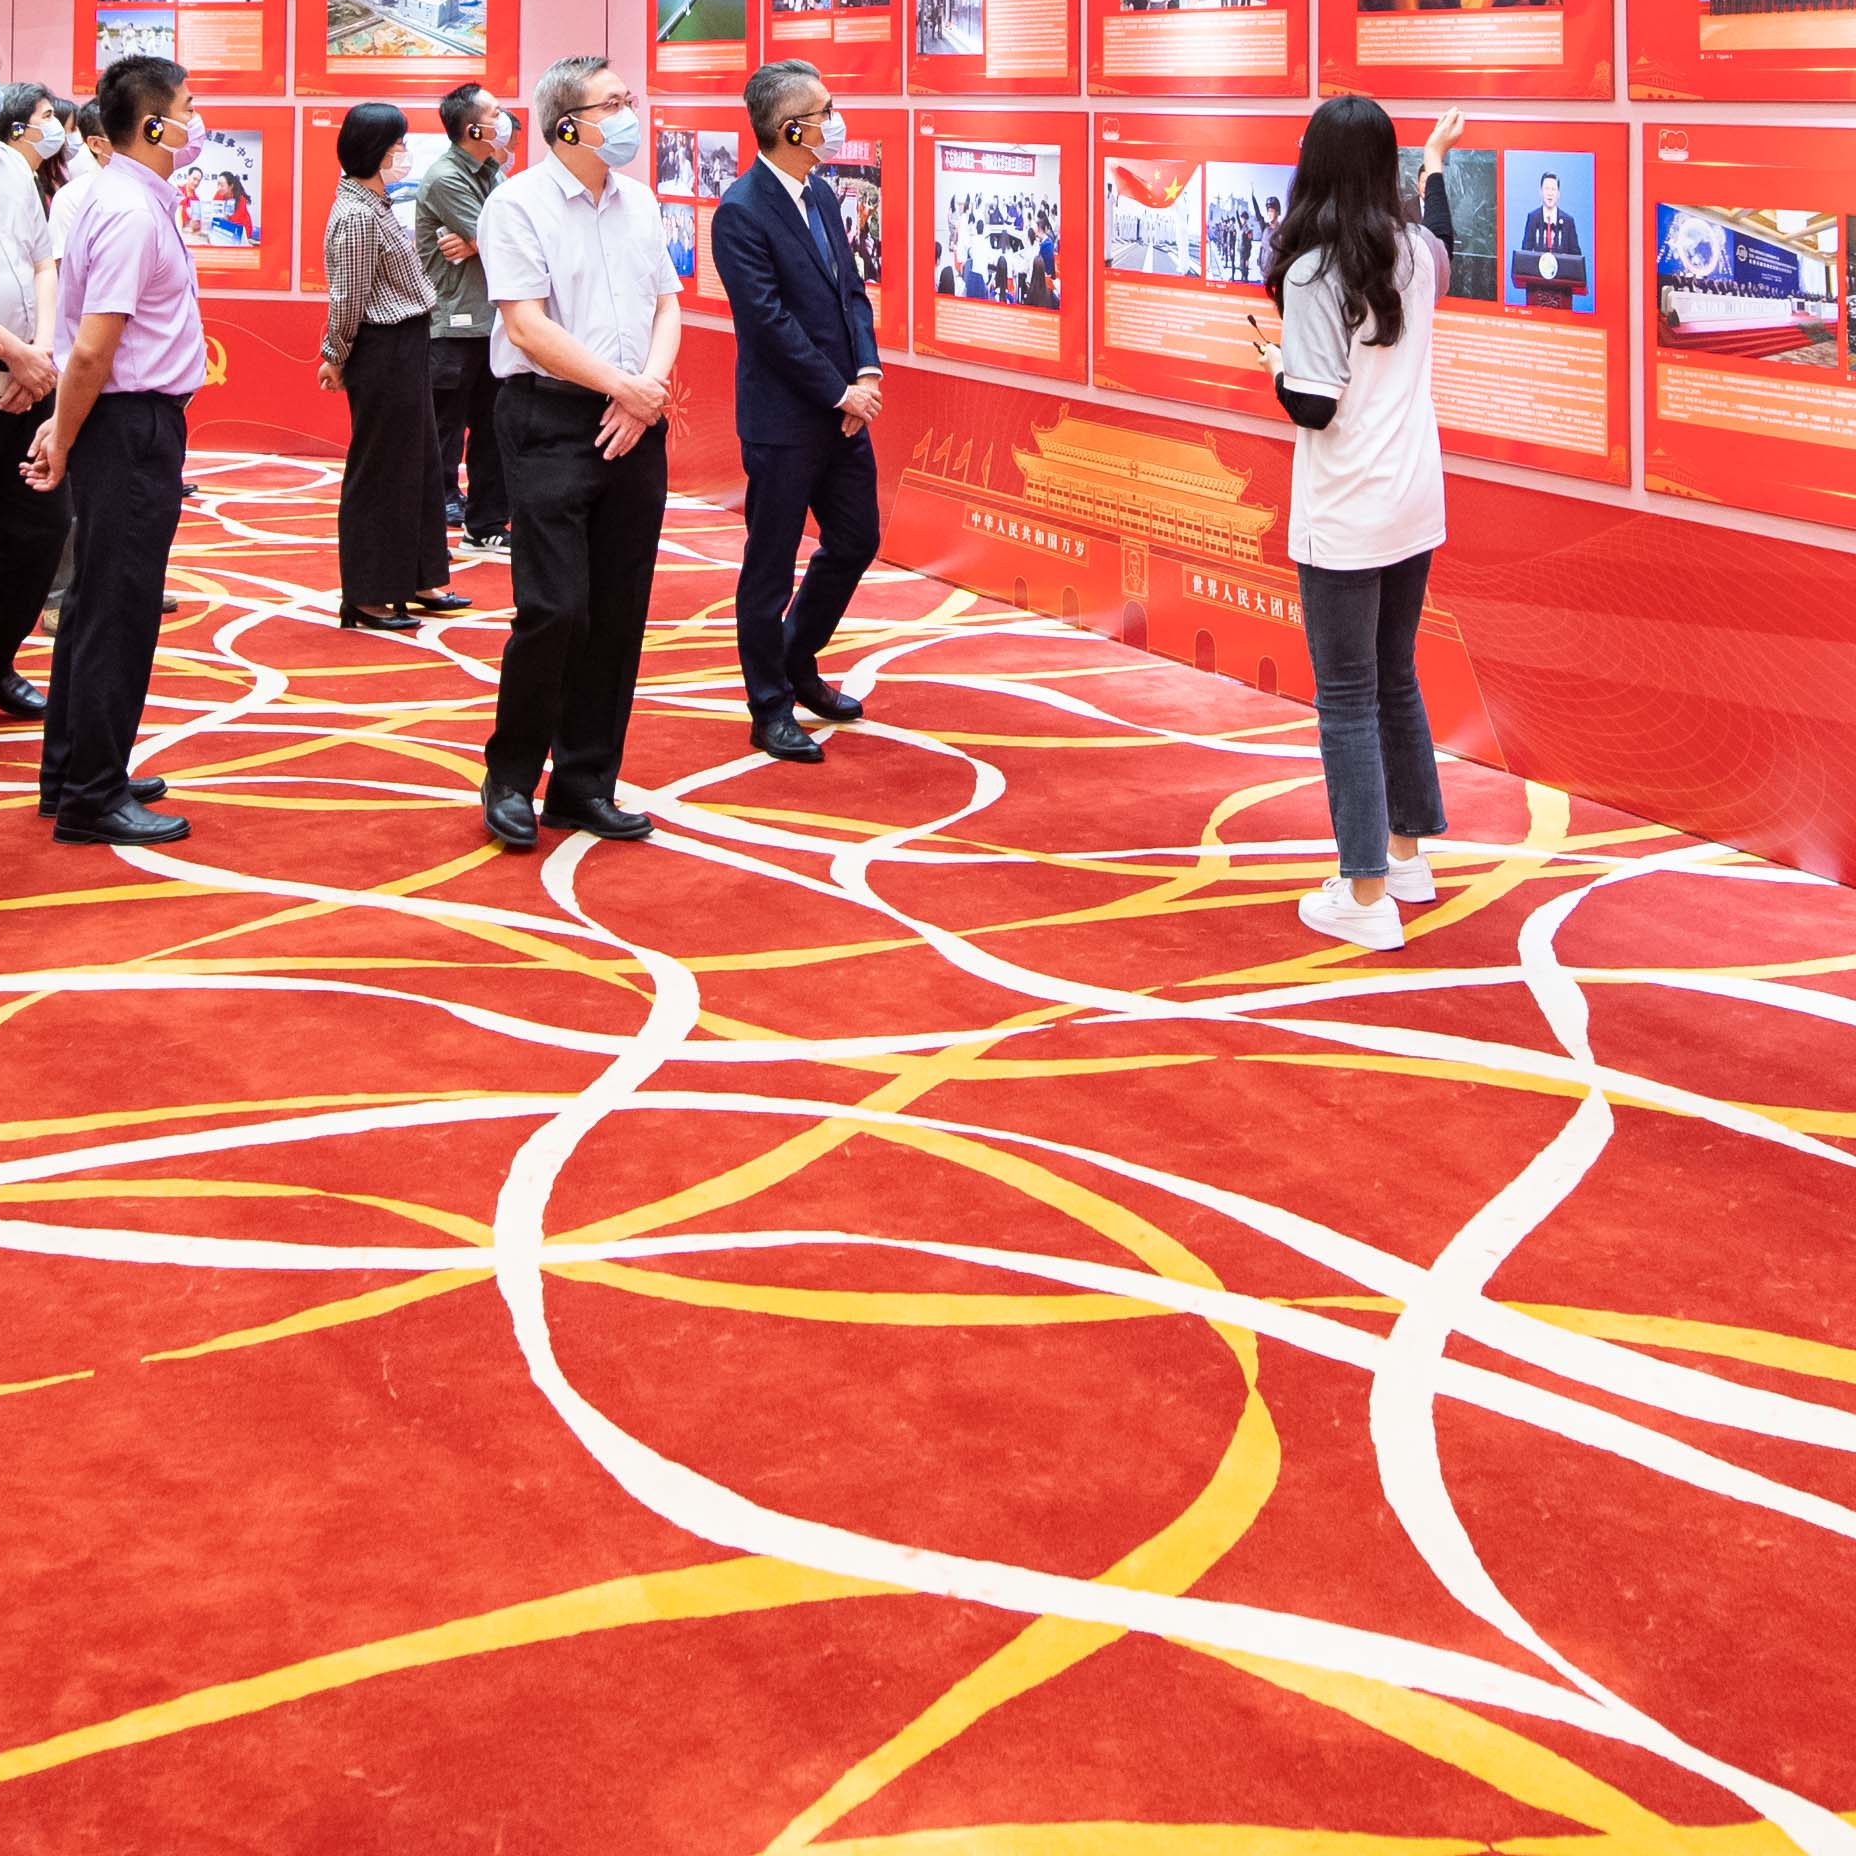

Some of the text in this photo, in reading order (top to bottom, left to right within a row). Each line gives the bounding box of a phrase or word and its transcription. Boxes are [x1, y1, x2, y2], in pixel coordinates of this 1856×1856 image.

[972, 511, 1086, 558] 中华人民共和国万岁
